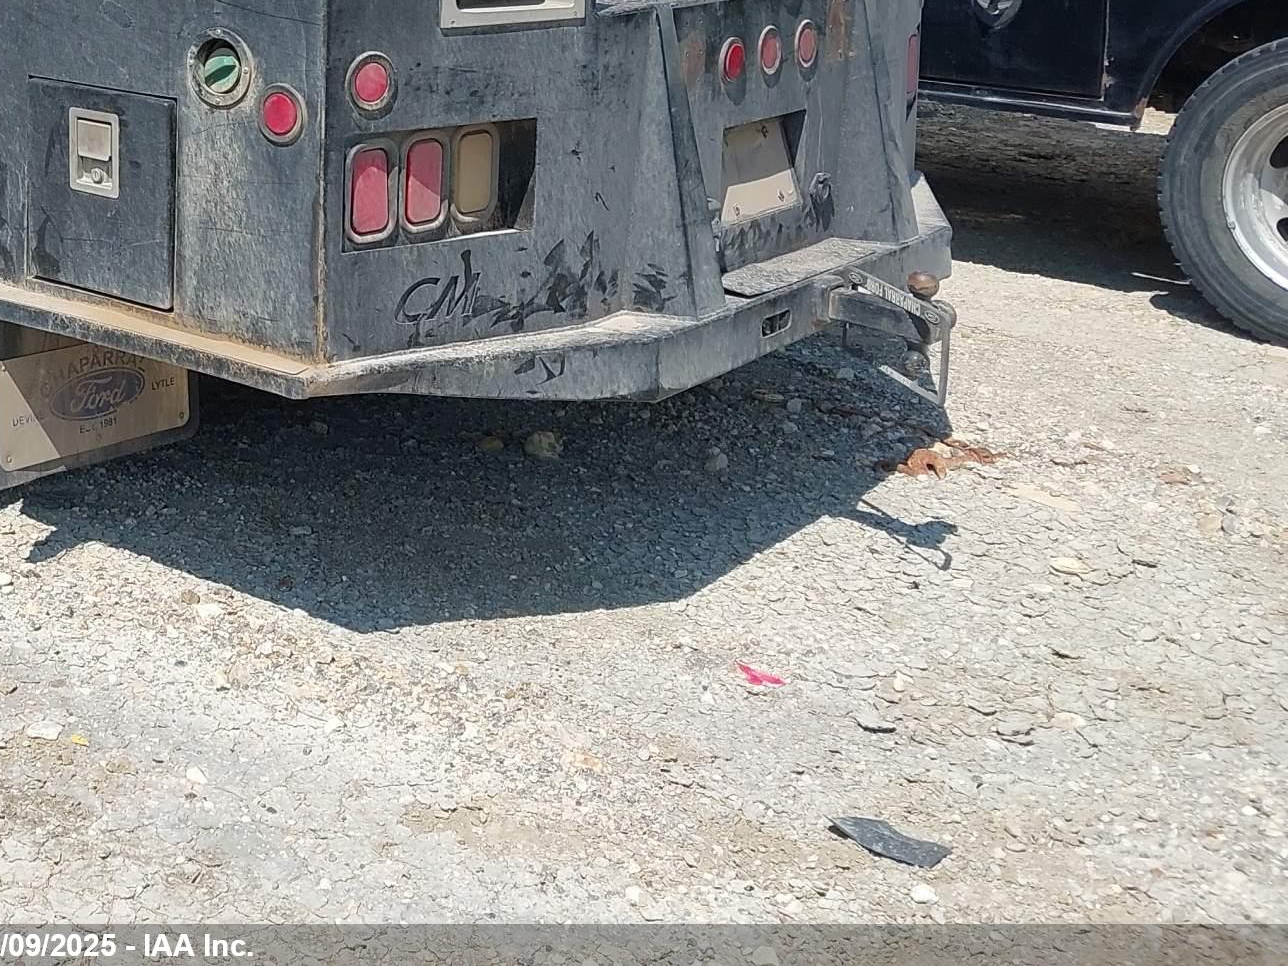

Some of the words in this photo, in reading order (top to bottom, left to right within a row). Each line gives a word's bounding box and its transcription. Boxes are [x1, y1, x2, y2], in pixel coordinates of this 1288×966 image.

[884, 285, 921, 317] CHAPARRAL
[70, 375, 127, 413] Ford
[151, 376, 176, 391] LYTLE
[12, 411, 46, 427] DEVIE
